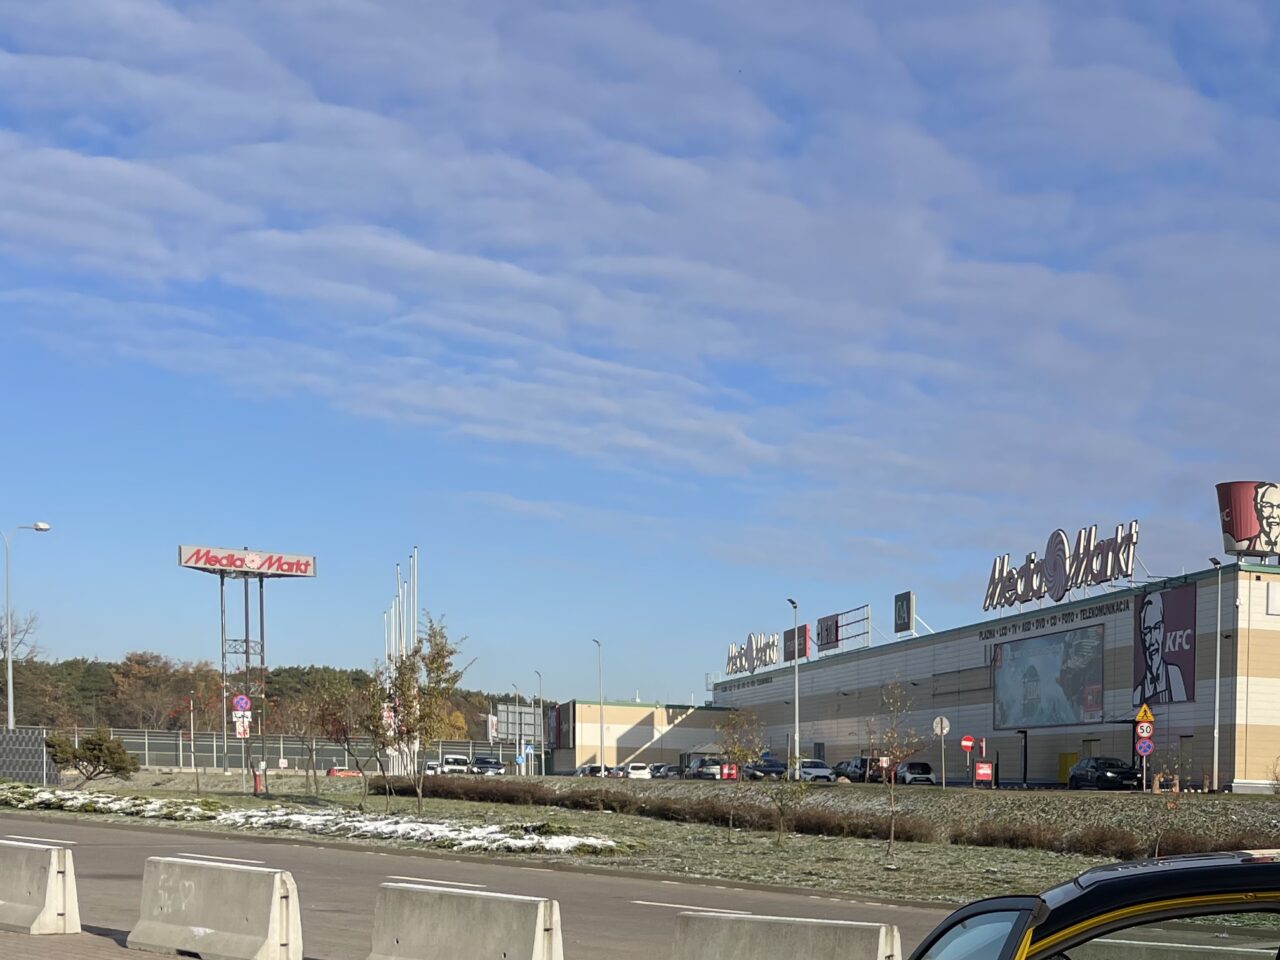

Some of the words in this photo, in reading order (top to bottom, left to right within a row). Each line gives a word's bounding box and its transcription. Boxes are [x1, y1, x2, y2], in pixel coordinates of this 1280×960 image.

[184, 549, 245, 568] Media
[258, 555, 311, 573] Markt
[984, 552, 1048, 611] Media
[1067, 520, 1138, 588] Markt
[1164, 629, 1192, 653] KFC
[1139, 725, 1152, 733] 50
